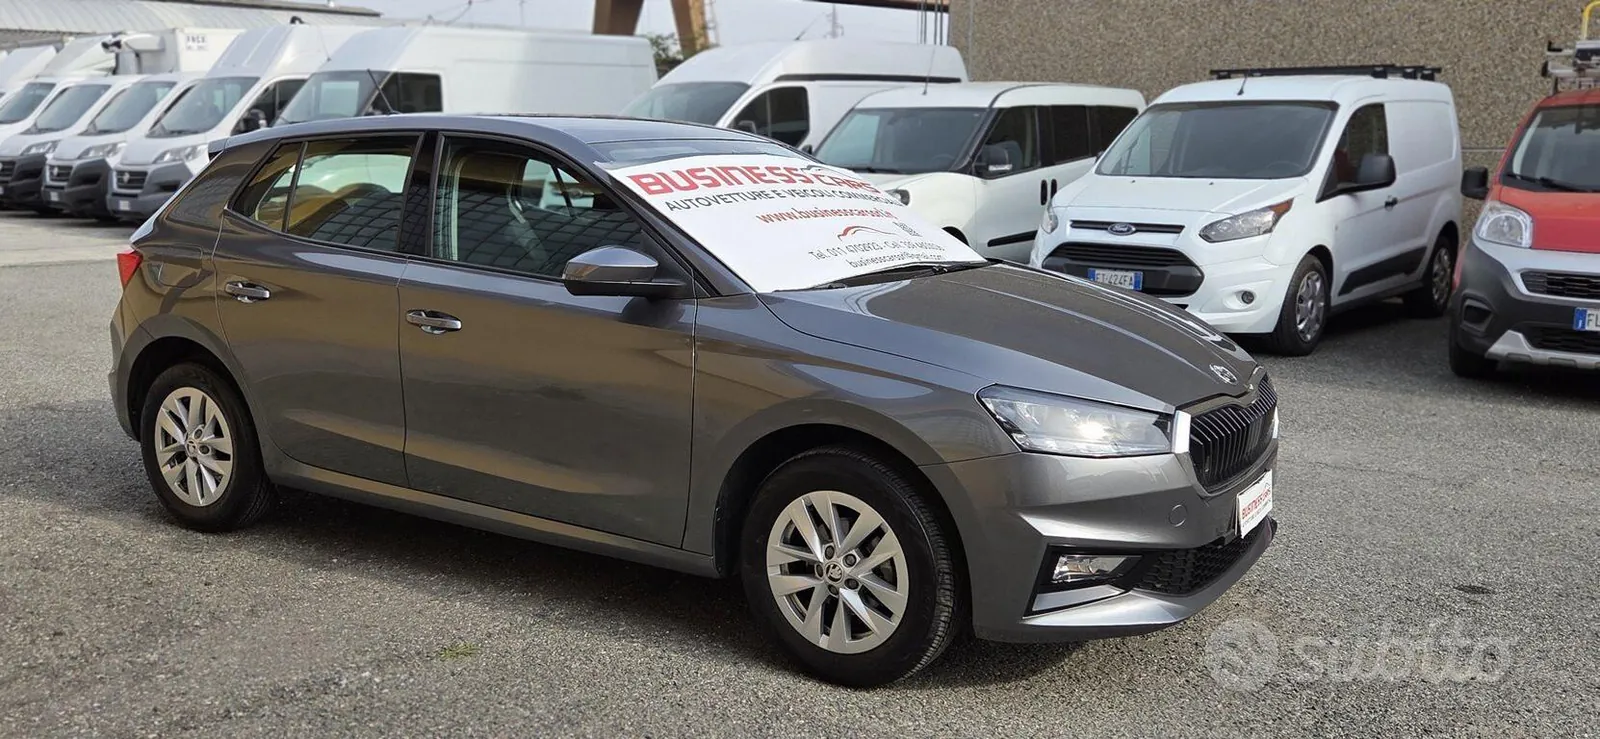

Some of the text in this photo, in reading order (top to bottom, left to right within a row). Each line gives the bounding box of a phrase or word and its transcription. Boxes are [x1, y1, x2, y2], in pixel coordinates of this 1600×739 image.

[626, 166, 881, 195] BUSINESS CARS
[664, 190, 775, 212] AUTOVETTURE
[781, 189, 833, 199] VEICOLI
[808, 249, 831, 260] Tel.
[827, 246, 848, 256] 011
